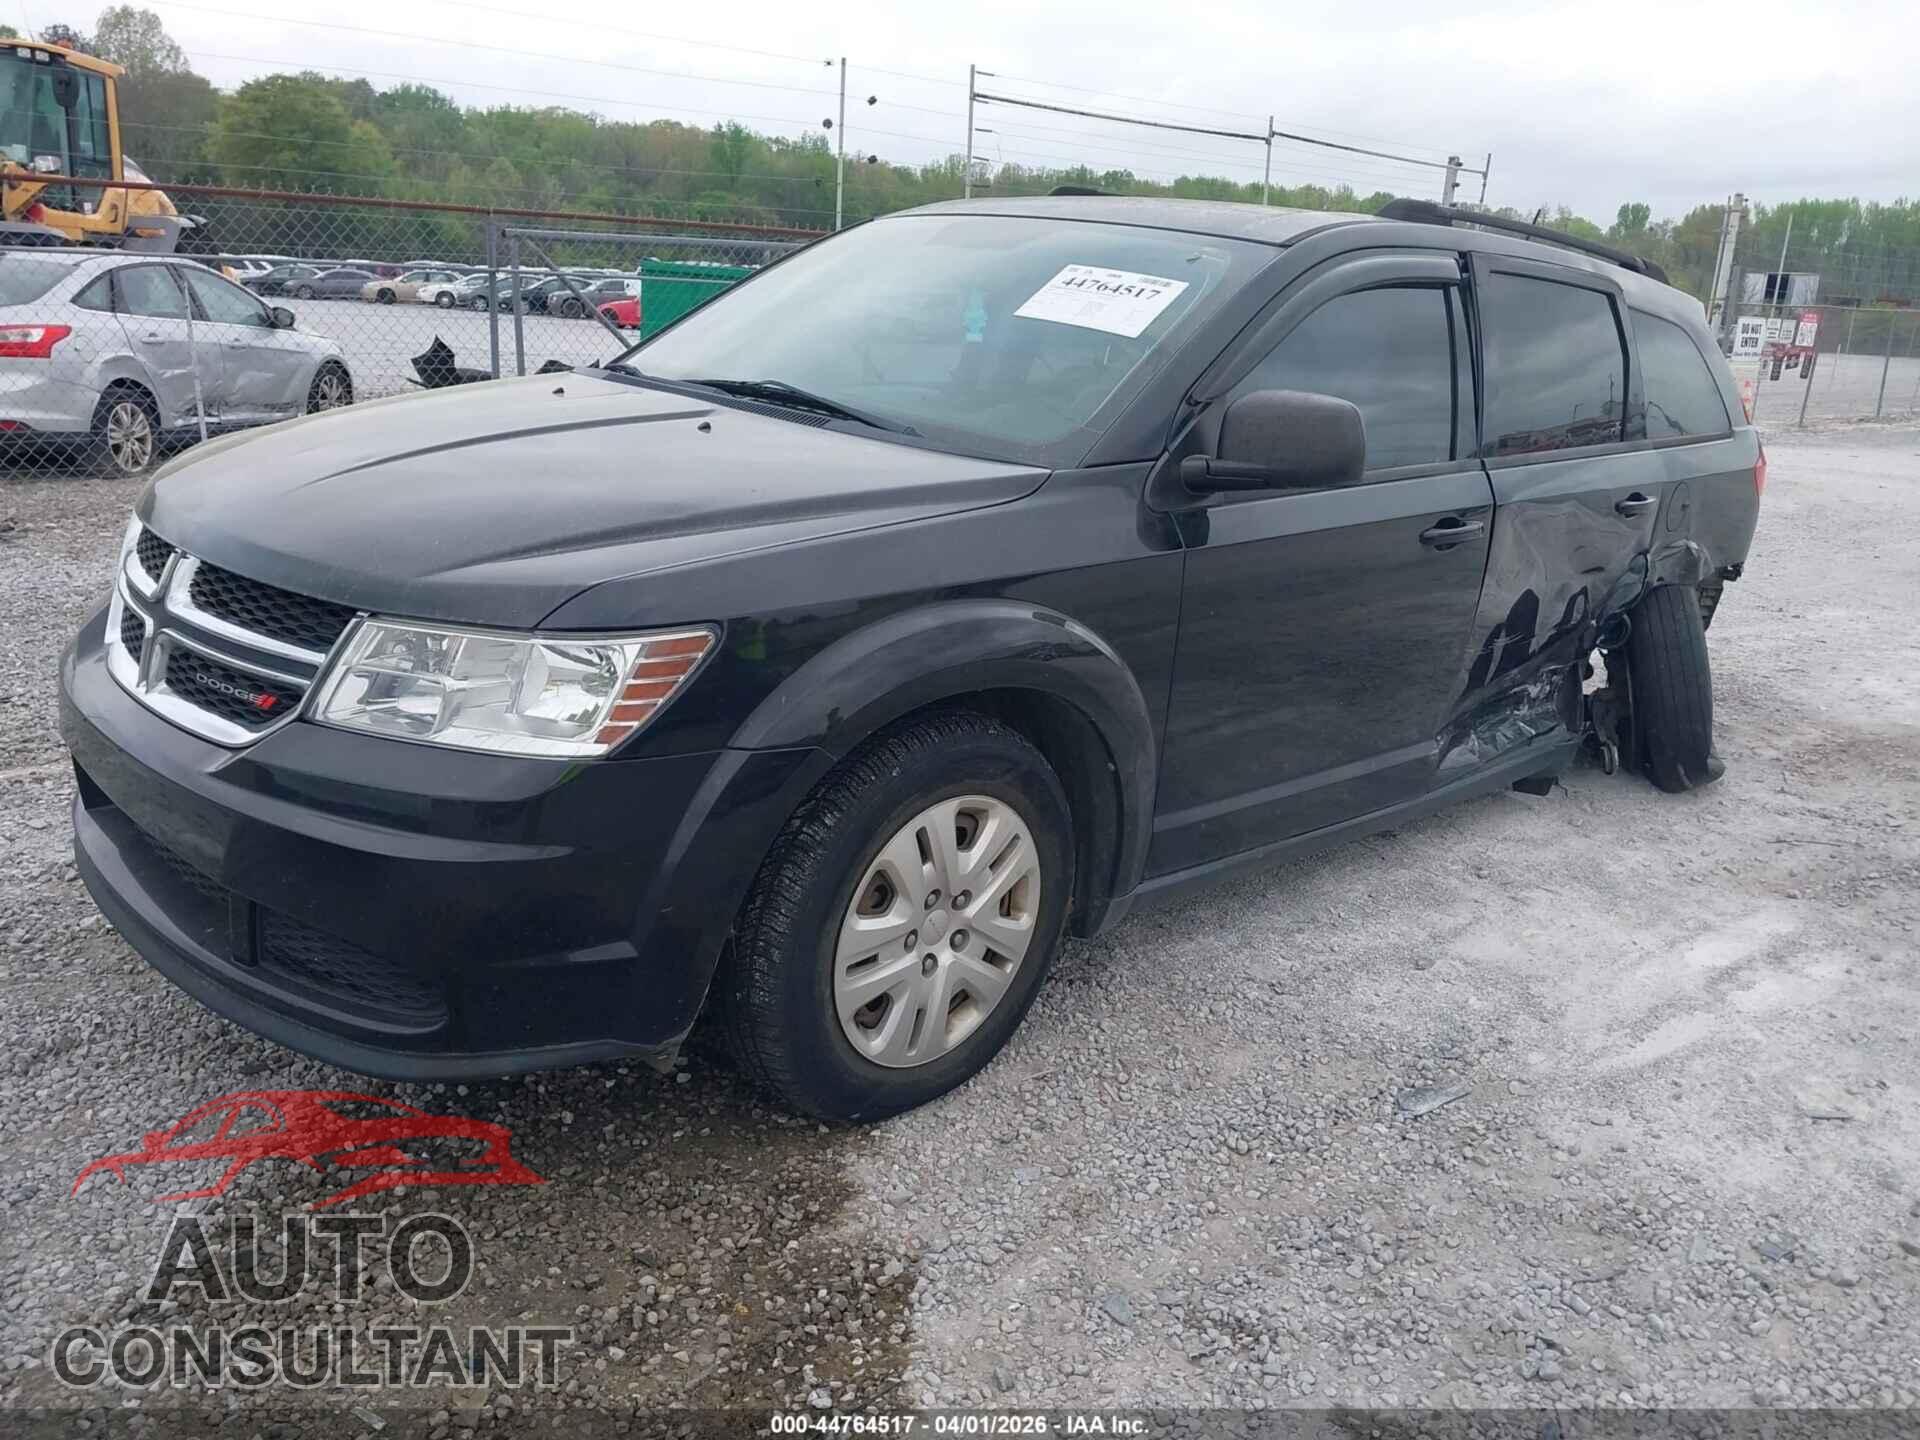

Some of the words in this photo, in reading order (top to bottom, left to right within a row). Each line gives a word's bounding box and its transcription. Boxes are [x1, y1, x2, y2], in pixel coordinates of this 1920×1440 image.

[1061, 276, 1162, 301] 44764517
[1741, 323, 1750, 335] DO
[1751, 323, 1762, 335] NOT
[1740, 337, 1760, 348] ENTER
[196, 672, 262, 705] DODGE
